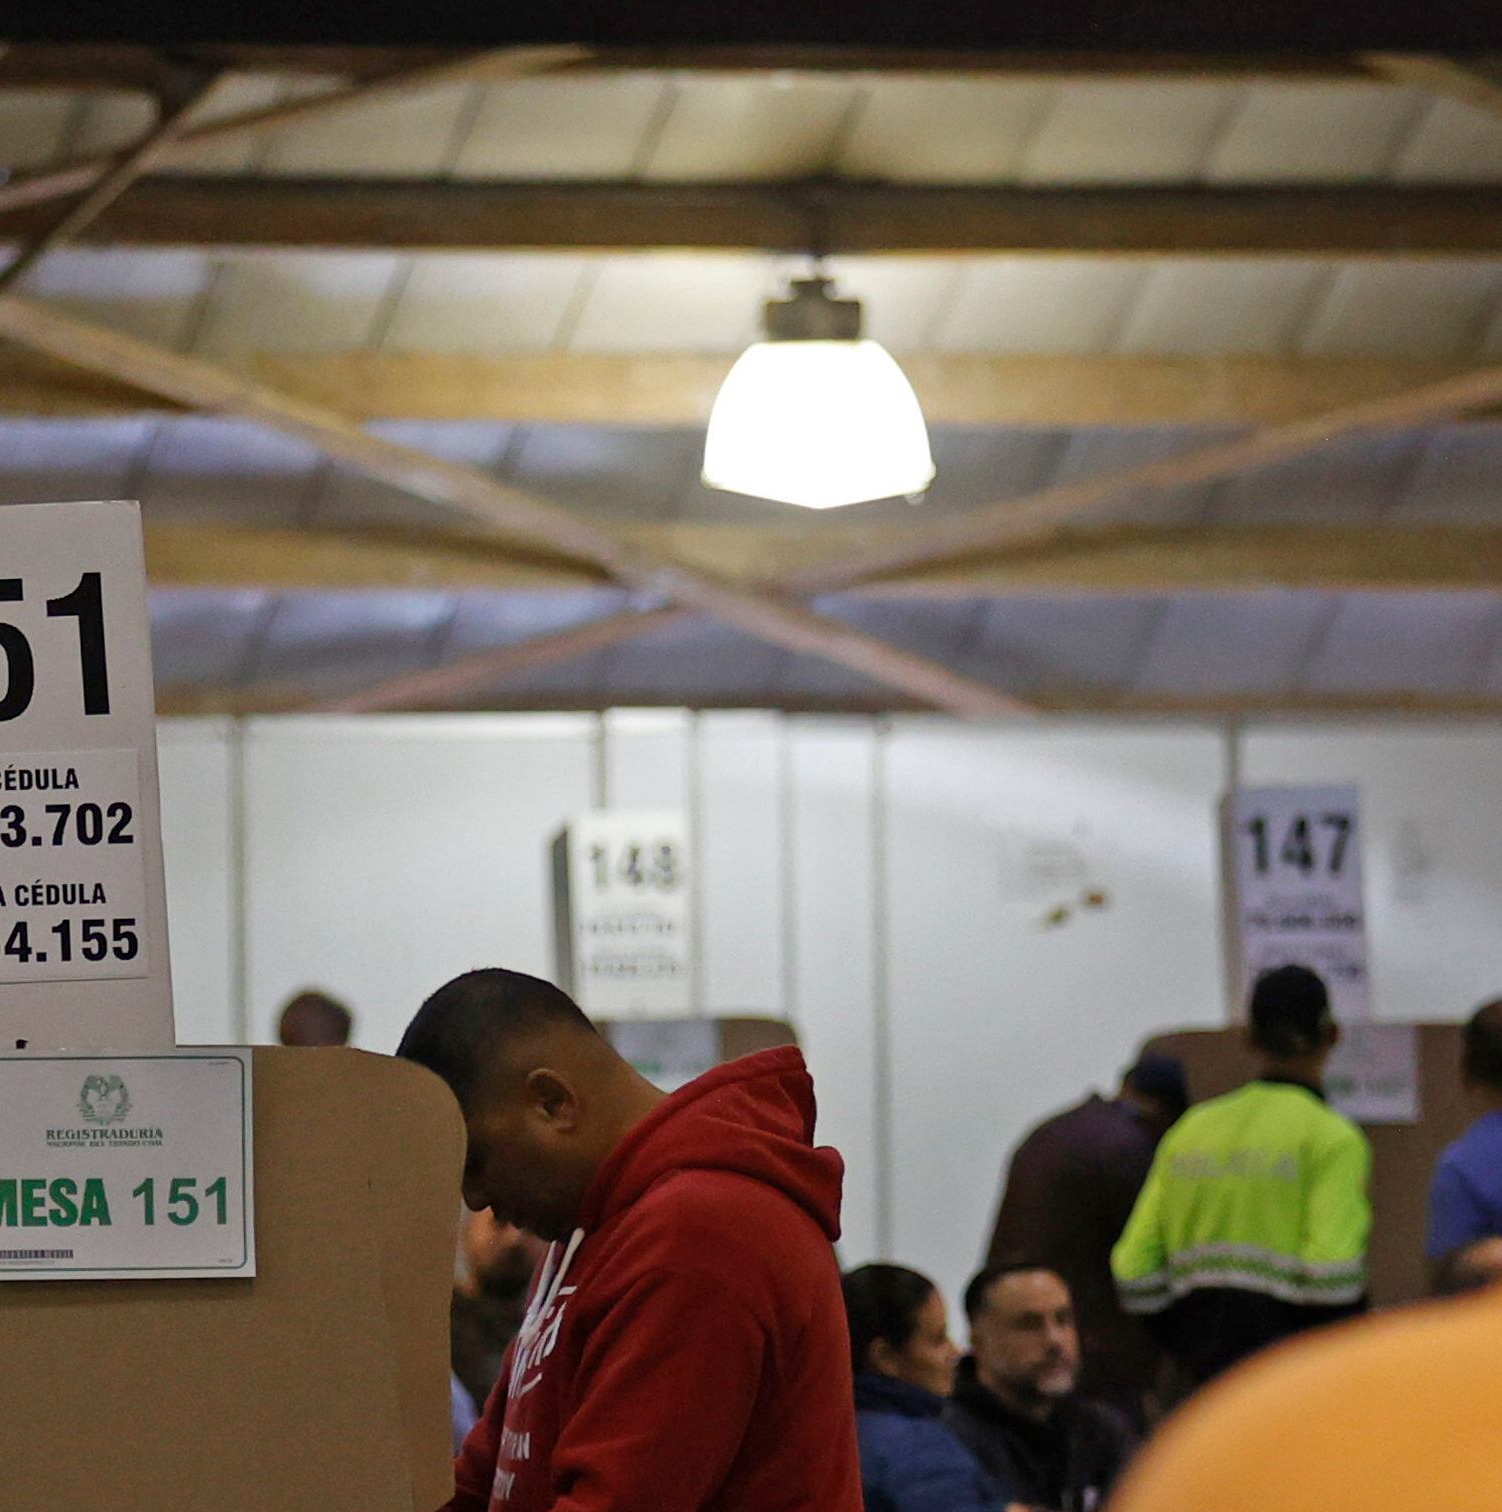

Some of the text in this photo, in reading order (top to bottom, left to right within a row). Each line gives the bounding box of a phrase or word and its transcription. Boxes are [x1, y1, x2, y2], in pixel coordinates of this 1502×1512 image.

[1245, 814, 1352, 874] 147
[14, 879, 107, 907] CÉDULA
[132, 1177, 227, 1226] 151
